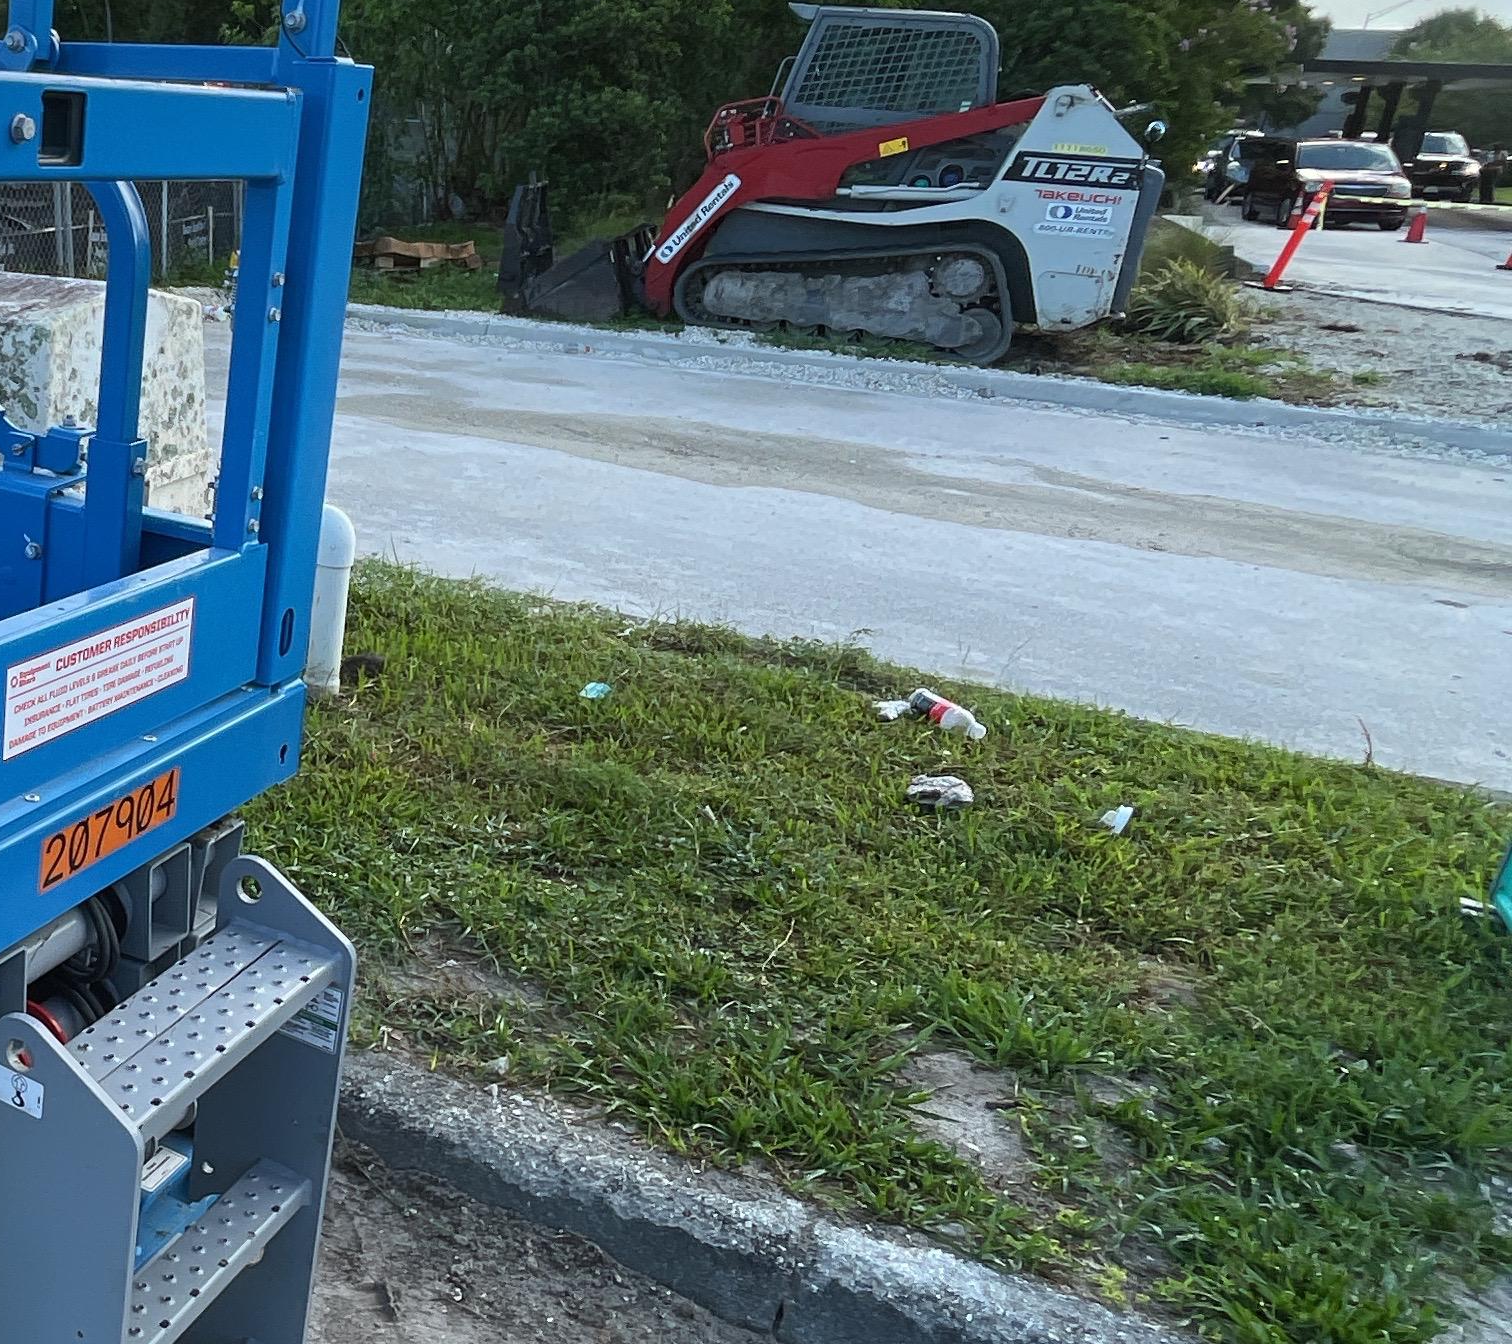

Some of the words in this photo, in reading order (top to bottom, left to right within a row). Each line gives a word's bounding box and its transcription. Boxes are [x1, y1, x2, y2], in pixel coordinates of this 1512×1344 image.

[1021, 156, 1130, 185] TL12R2
[672, 213, 703, 246] United
[701, 180, 734, 217] Rentals
[1034, 189, 1122, 205] TAKEUCHI
[1074, 206, 1108, 216] United
[55, 640, 112, 672] CUSTOMER
[114, 607, 190, 647] RESPONSIBILITY
[14, 697, 36, 714] CHECK
[49, 685, 68, 699] FLUID
[69, 675, 91, 692] LEVELS
[9, 729, 38, 749] DAMAGE
[47, 709, 84, 732] EQUIPMENT
[87, 697, 114, 715] BATTERY
[42, 769, 176, 889] 207904
